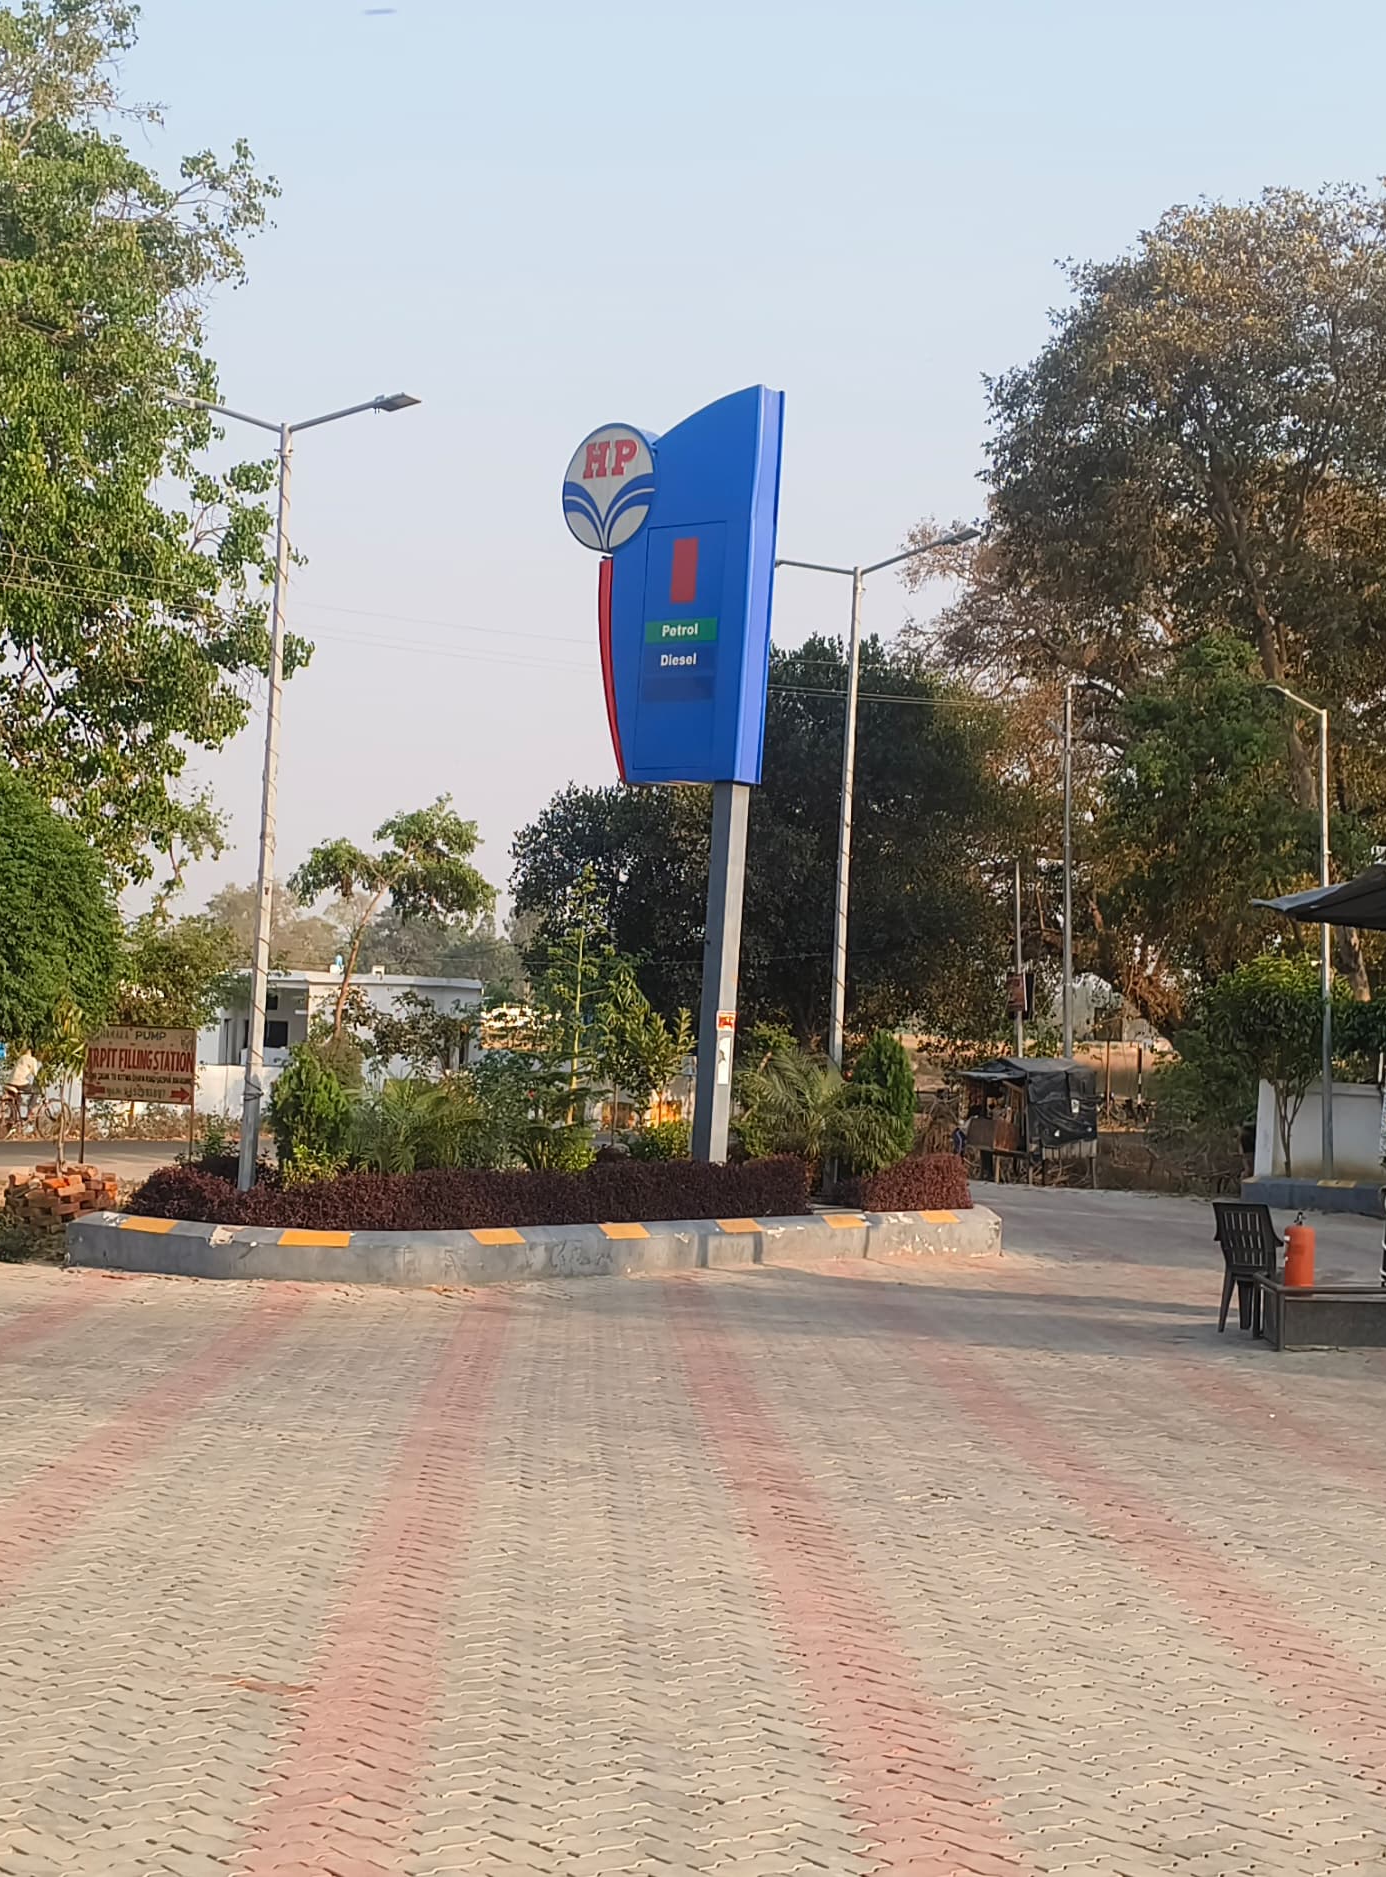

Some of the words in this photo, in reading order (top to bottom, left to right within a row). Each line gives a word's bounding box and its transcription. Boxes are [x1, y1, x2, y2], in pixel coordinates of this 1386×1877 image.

[583, 439, 638, 479] HP
[662, 623, 699, 637] Petrol
[661, 652, 697, 666] Diesel
[135, 1030, 167, 1041] PUMP
[119, 1048, 153, 1070] FILLING
[153, 1050, 194, 1073] STATION
